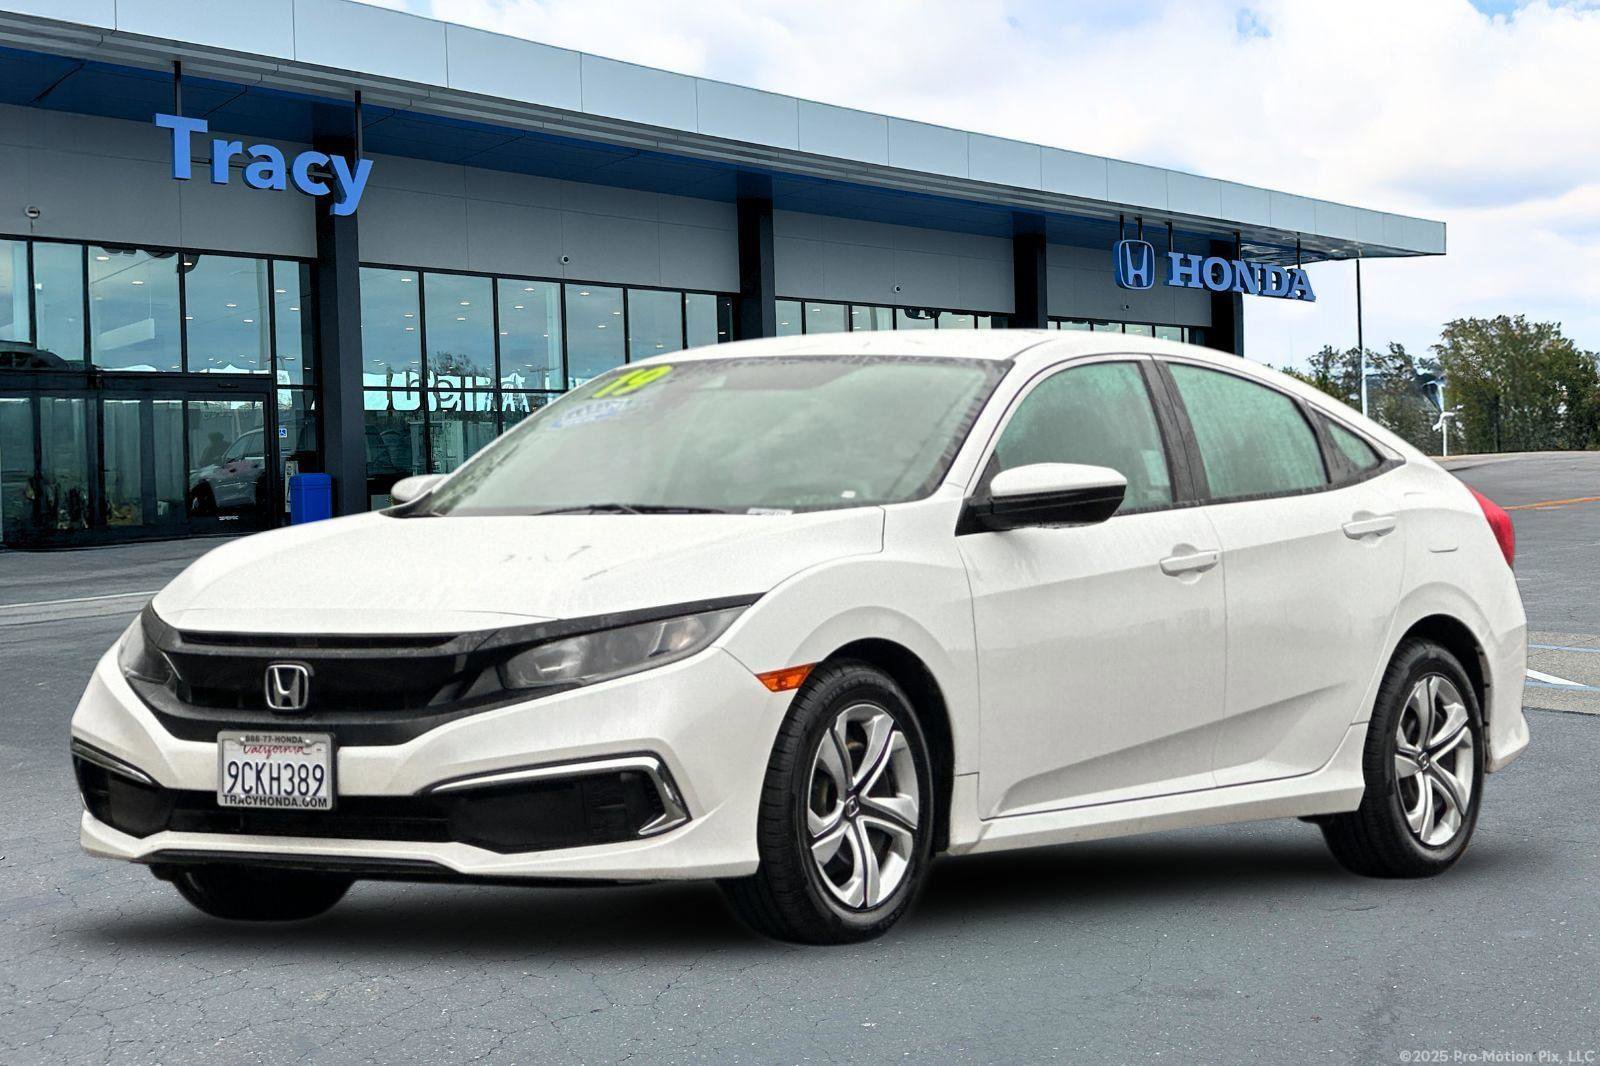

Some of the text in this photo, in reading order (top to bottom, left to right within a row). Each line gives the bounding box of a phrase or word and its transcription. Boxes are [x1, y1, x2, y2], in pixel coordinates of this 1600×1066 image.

[153, 113, 374, 217] Tracy
[1166, 251, 1317, 302] HONDA
[226, 760, 325, 797] 9CKH389
[222, 794, 328, 808] TRACYHONDA.COM
